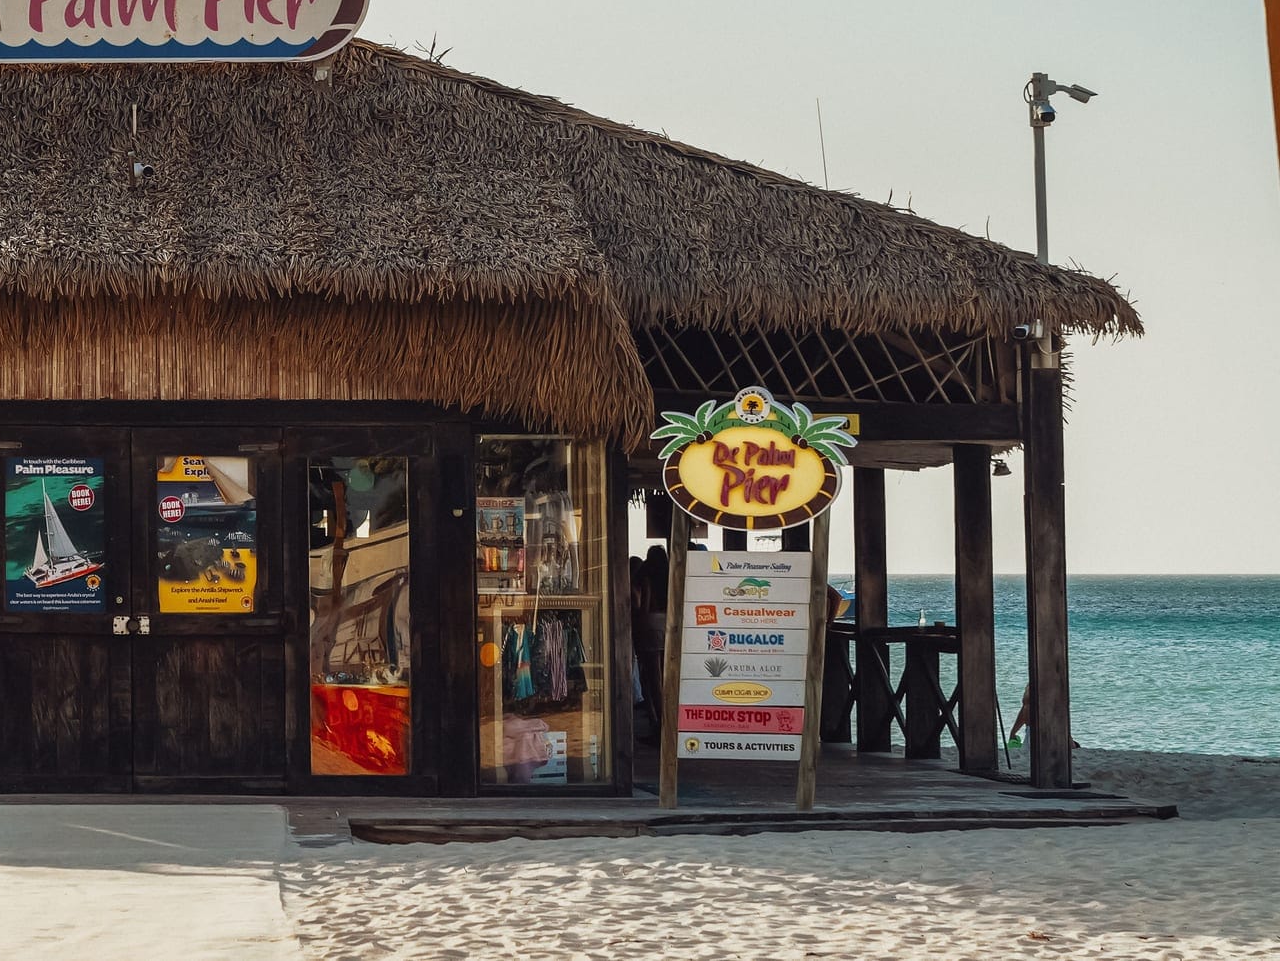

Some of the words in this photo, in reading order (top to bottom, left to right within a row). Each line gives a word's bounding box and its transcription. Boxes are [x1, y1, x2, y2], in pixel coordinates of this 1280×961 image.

[712, 440, 739, 465] De
[742, 440, 796, 469] Palm
[15, 464, 44, 474] Palm
[44, 464, 94, 475] Pleasure
[716, 463, 790, 508] Pier
[71, 489, 91, 499] BOOK
[72, 497, 92, 507] HERE!
[161, 500, 181, 510] BOOK
[162, 508, 182, 518] HERE!
[726, 561, 742, 570] Palm
[742, 561, 770, 570] Pleasure
[769, 562, 792, 573] Sailing
[216, 586, 244, 594] Shipwreck
[723, 606, 796, 618] Casualwear
[728, 633, 785, 646] BUGALOE
[728, 664, 756, 672] ARUBA
[759, 664, 782, 672] ALOE
[684, 708, 704, 719] THE
[704, 709, 736, 722] DOCK
[736, 710, 772, 727] STOP
[703, 741, 735, 751] TOURS
[736, 742, 743, 751] &
[744, 742, 796, 752] ACTIVITIES
